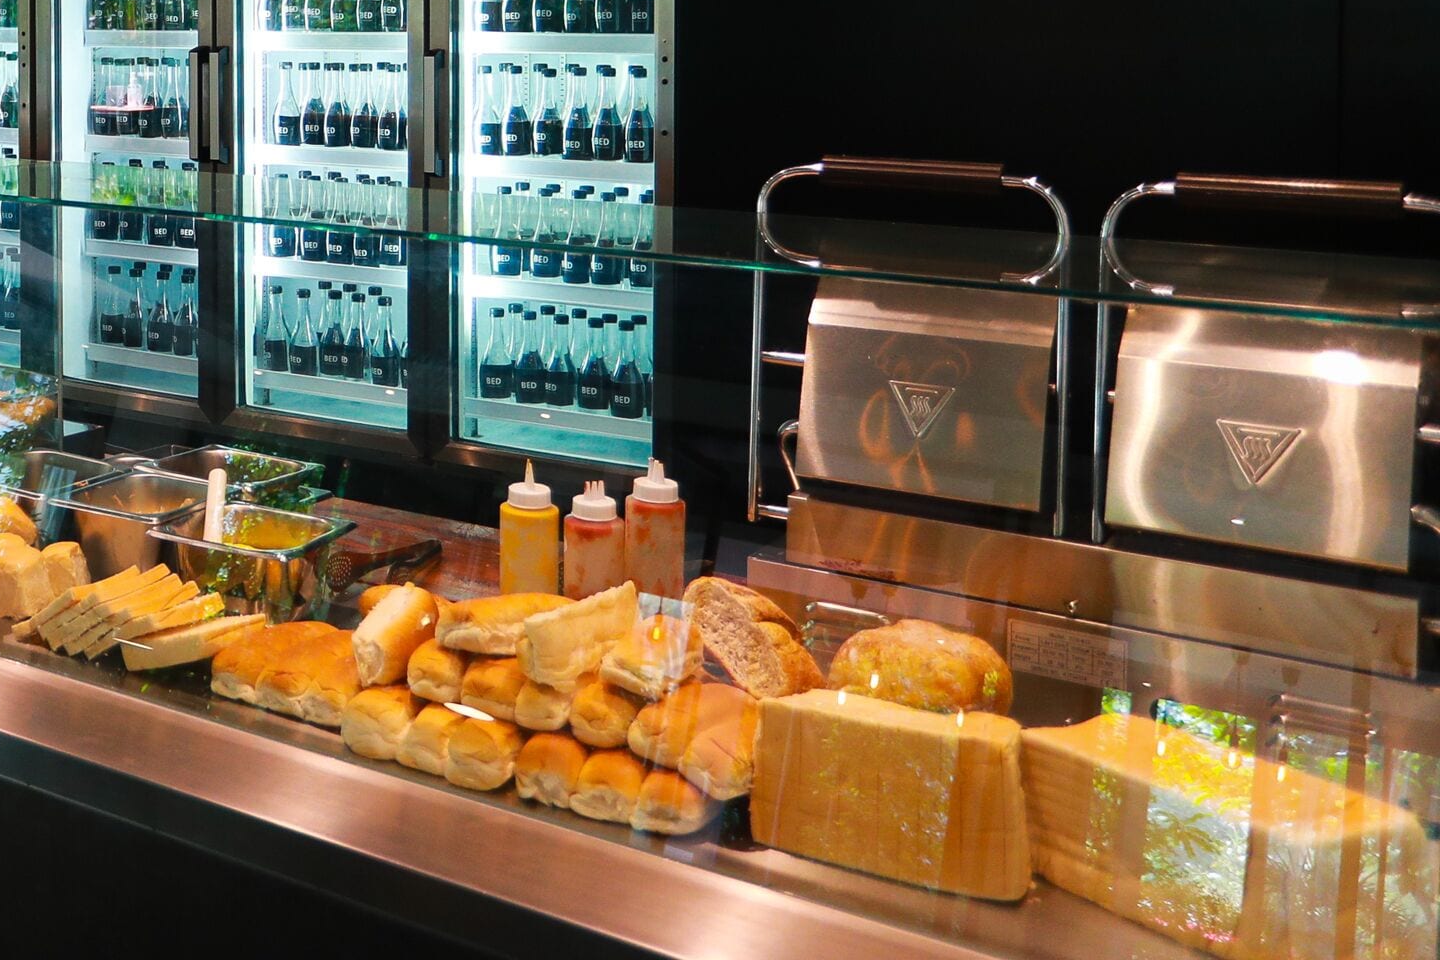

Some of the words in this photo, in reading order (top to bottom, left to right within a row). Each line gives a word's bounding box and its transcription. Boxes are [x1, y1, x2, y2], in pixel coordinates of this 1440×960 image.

[505, 12, 520, 20] BED
[597, 11, 612, 19] BED
[305, 124, 319, 132] BED
[565, 140, 580, 148] BED
[594, 138, 609, 146] BED
[629, 141, 645, 149] BED
[304, 241, 318, 249] BED
[329, 244, 342, 252] BED
[486, 377, 501, 385] BED
[545, 382, 557, 391] BED
[581, 387, 597, 395] BED
[614, 395, 630, 404] BED
